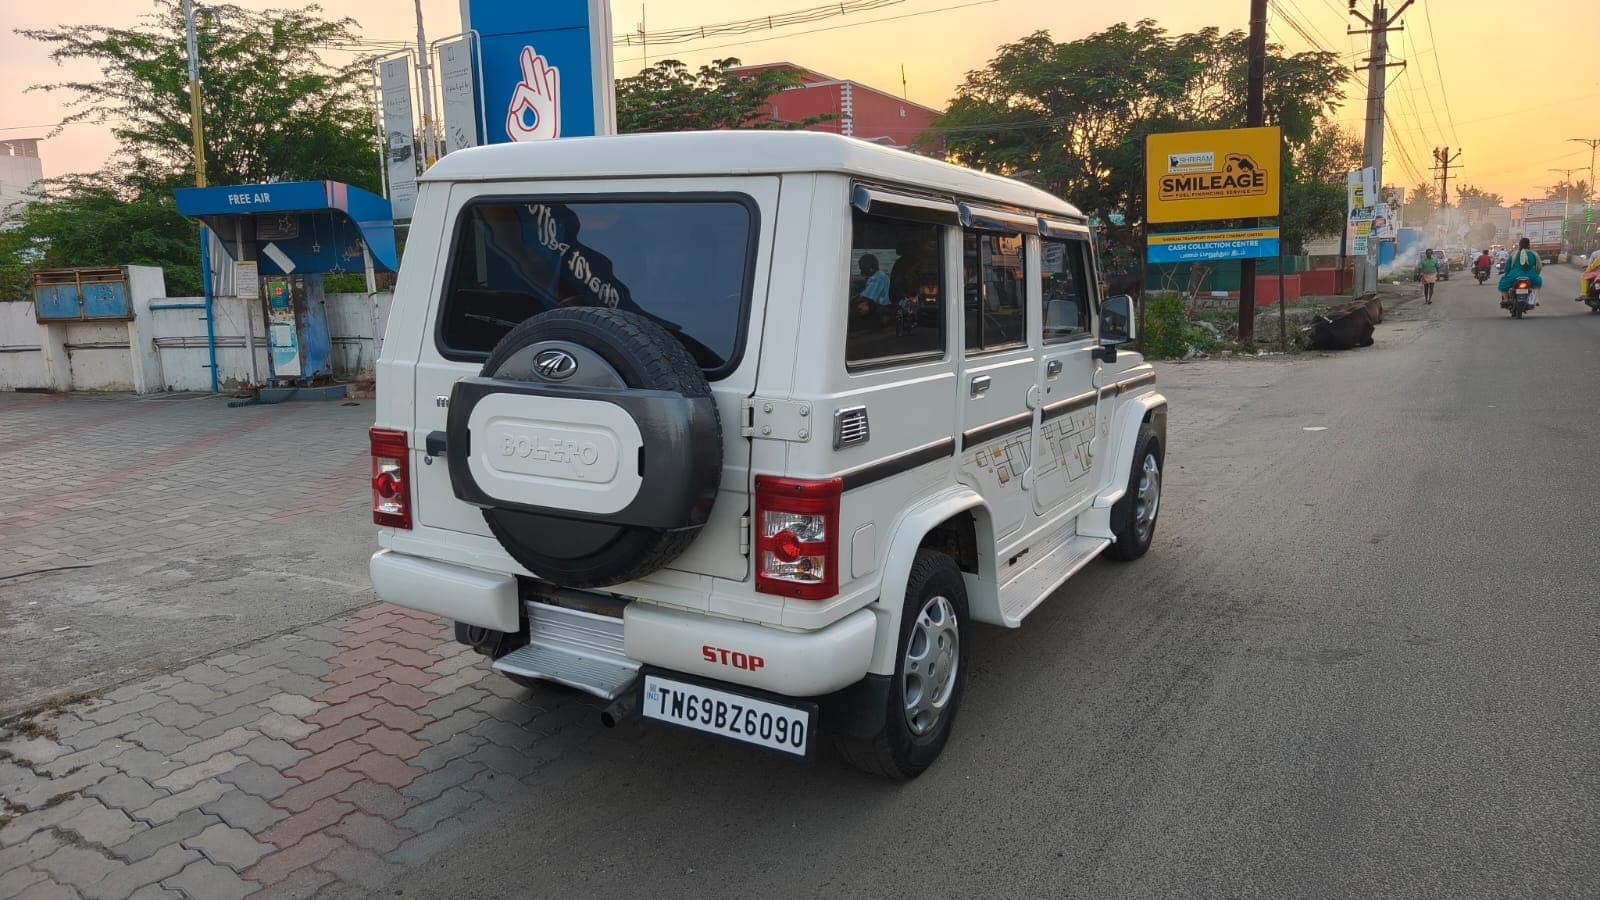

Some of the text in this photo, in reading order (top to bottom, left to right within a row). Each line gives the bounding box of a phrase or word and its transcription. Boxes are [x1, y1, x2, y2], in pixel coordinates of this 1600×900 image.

[1179, 155, 1213, 164] SHRIRAM
[1163, 173, 1264, 192] SMILEAGE
[228, 192, 271, 205] FREE AIR
[1188, 241, 1231, 250] COLLECTION
[1232, 240, 1259, 248] CENTRE
[503, 433, 599, 466] BOLERO
[702, 645, 765, 672] STOP
[658, 687, 804, 748] TN69BZ6090
